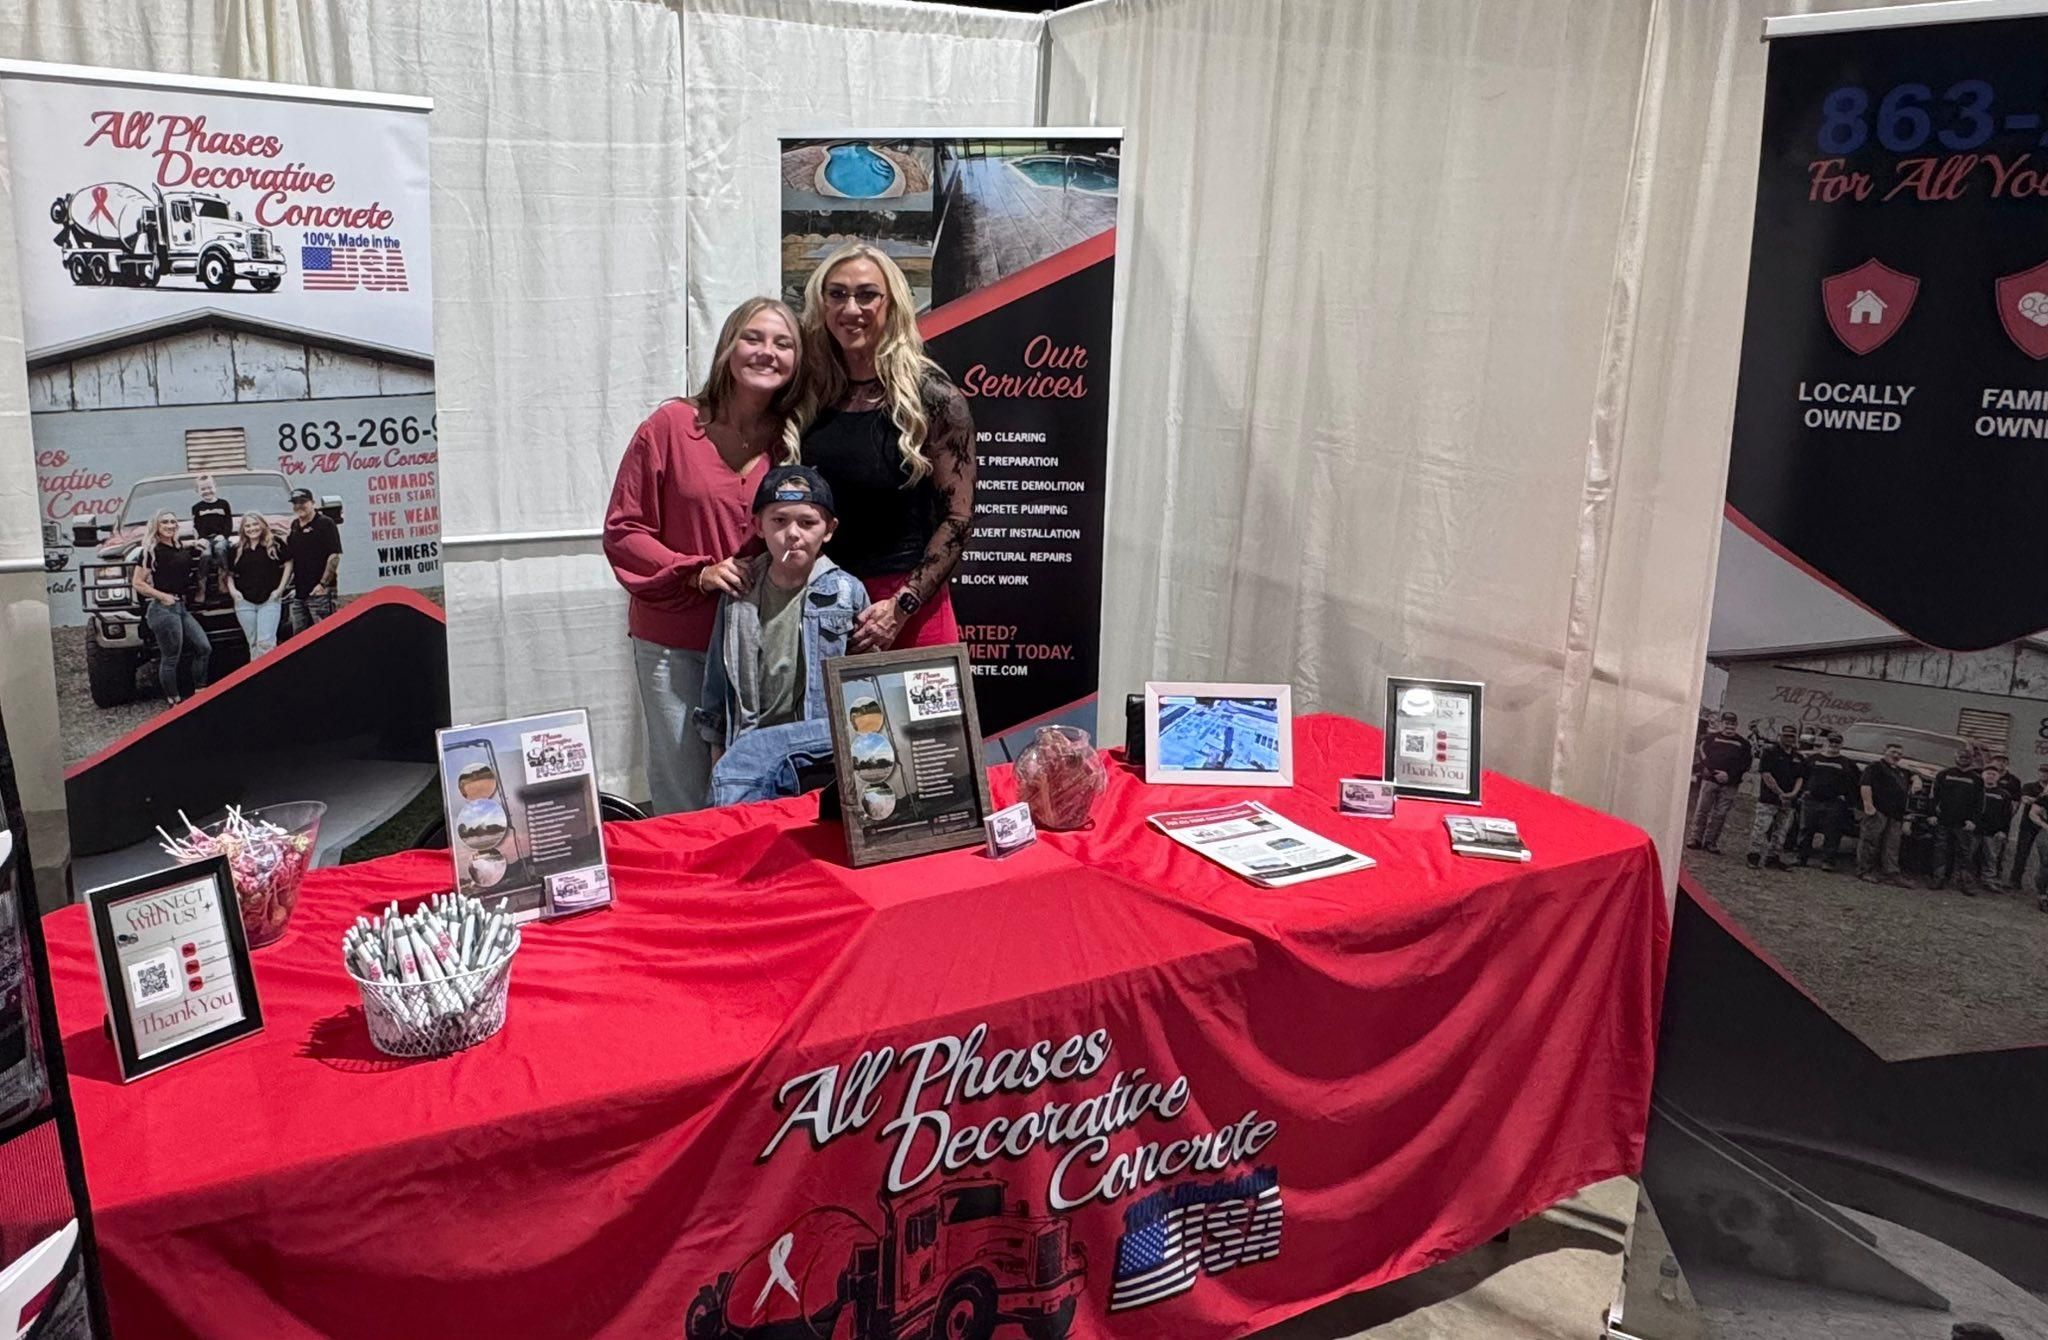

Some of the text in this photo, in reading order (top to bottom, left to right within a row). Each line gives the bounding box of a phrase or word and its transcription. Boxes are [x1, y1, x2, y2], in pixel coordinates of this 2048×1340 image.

[1817, 79, 2048, 155] 863-
[84, 111, 283, 158] All Phases
[152, 151, 335, 194] Decorative
[1808, 158, 1875, 202] For
[1881, 154, 1978, 201] All
[255, 190, 394, 230] Concrete
[303, 232, 400, 248] 100% Made in the
[302, 247, 409, 291] USA
[1024, 334, 1088, 369] Our
[959, 364, 1088, 398] Services
[1799, 382, 1915, 406] LOCALLY
[1804, 409, 1901, 432] OWNED
[995, 432, 1046, 443] CLEARING
[35, 449, 70, 468] es
[278, 455, 307, 475] For
[310, 451, 341, 474] All
[341, 451, 382, 470] Your
[988, 456, 1058, 467] PREPARATION
[38, 468, 114, 492] rative
[368, 471, 435, 491] COWARDS
[976, 480, 1085, 492] NCRETE DEMOLITION
[368, 488, 436, 505] NEVER START
[370, 506, 439, 527] THE WEAK
[1020, 504, 1068, 515] PUMPING
[372, 524, 439, 541] NEVER FINISH
[1009, 529, 1081, 539] INSTALLATION
[377, 542, 438, 563] WINNERS
[961, 551, 1072, 563] STRUCTURAL REPAIRS
[378, 559, 439, 578] NEVER QUIT
[961, 575, 1029, 586] BLOCK WORK
[1015, 644, 1075, 660] TODAY.
[1401, 763, 1464, 780] Thank You
[126, 889, 204, 919] CONNECT
[173, 907, 198, 926] US!
[137, 999, 198, 1036] Thank
[199, 991, 234, 1014] You
[760, 1022, 1113, 1158] All Phases
[882, 1068, 1190, 1192] Decorative
[1049, 1110, 1278, 1209] Concrete
[1111, 1186, 1284, 1310] USA
